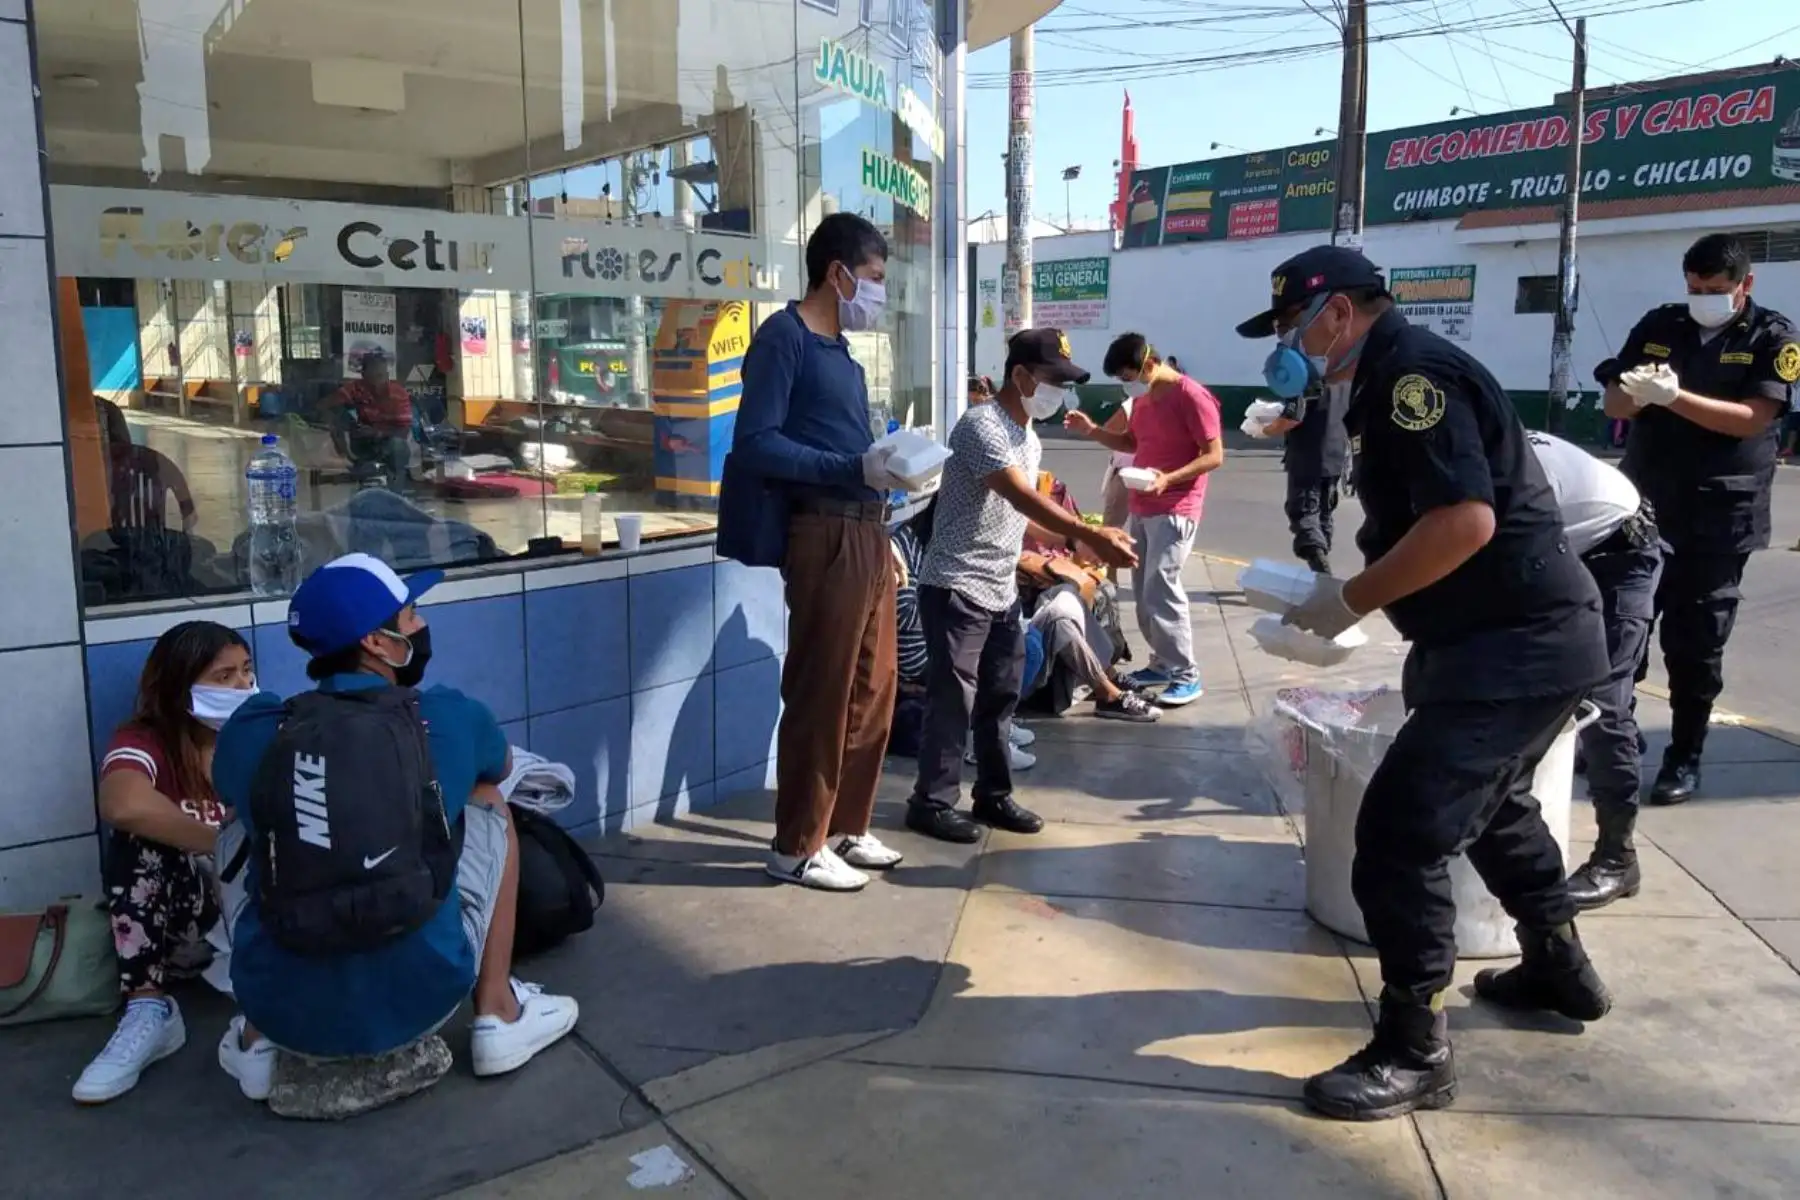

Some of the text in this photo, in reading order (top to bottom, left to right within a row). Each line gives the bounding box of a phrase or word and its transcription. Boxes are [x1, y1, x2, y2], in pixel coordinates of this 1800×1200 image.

[814, 38, 888, 107] JAUJA
[1642, 86, 1776, 136] CARGA
[1287, 149, 1330, 169] Cargo
[1284, 177, 1336, 199] Americ
[1393, 181, 1490, 211] CHIMBOTE
[1510, 169, 1611, 199] TRUJLO
[1633, 154, 1752, 187] CHICLAYO
[1039, 273, 1053, 288] EN
[1055, 270, 1107, 287] GENERAL
[712, 336, 745, 356] WIFI
[293, 750, 332, 850] NIKE
